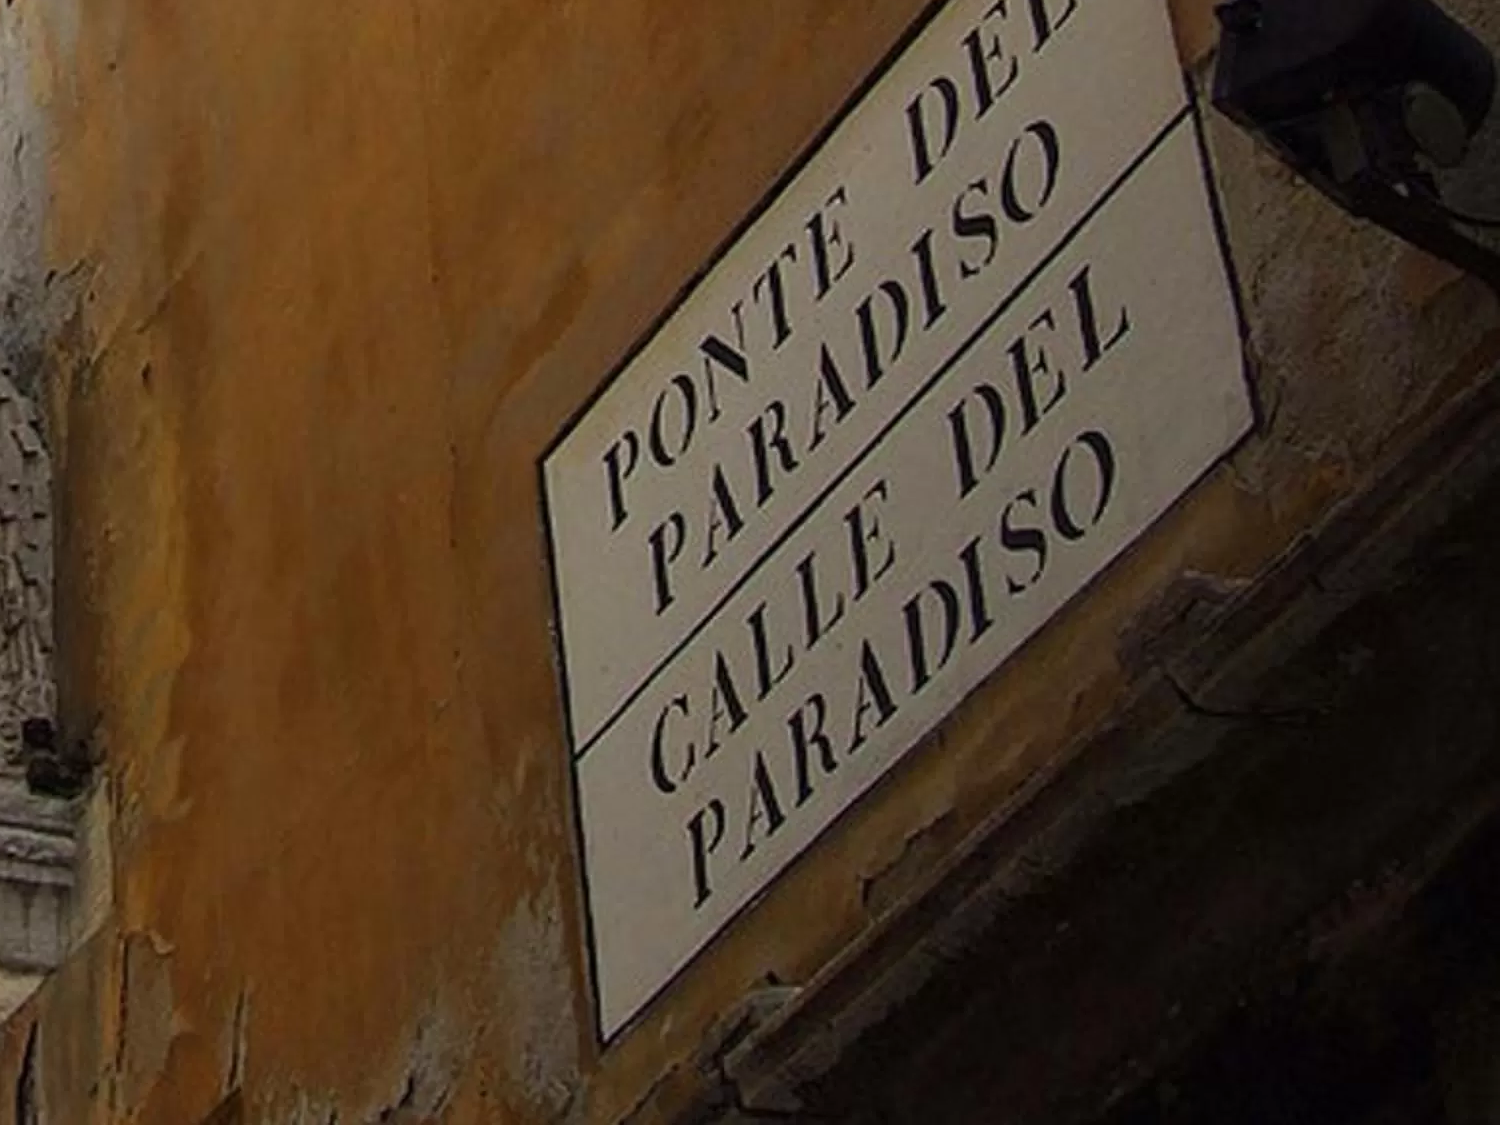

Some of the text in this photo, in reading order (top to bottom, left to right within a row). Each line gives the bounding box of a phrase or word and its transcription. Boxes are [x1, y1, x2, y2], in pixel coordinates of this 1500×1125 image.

[602, 185, 857, 533] PONTE
[647, 119, 1060, 617] PARADISO
[650, 263, 1131, 794] CALLE DEL
[686, 430, 1117, 911] PARADISO
